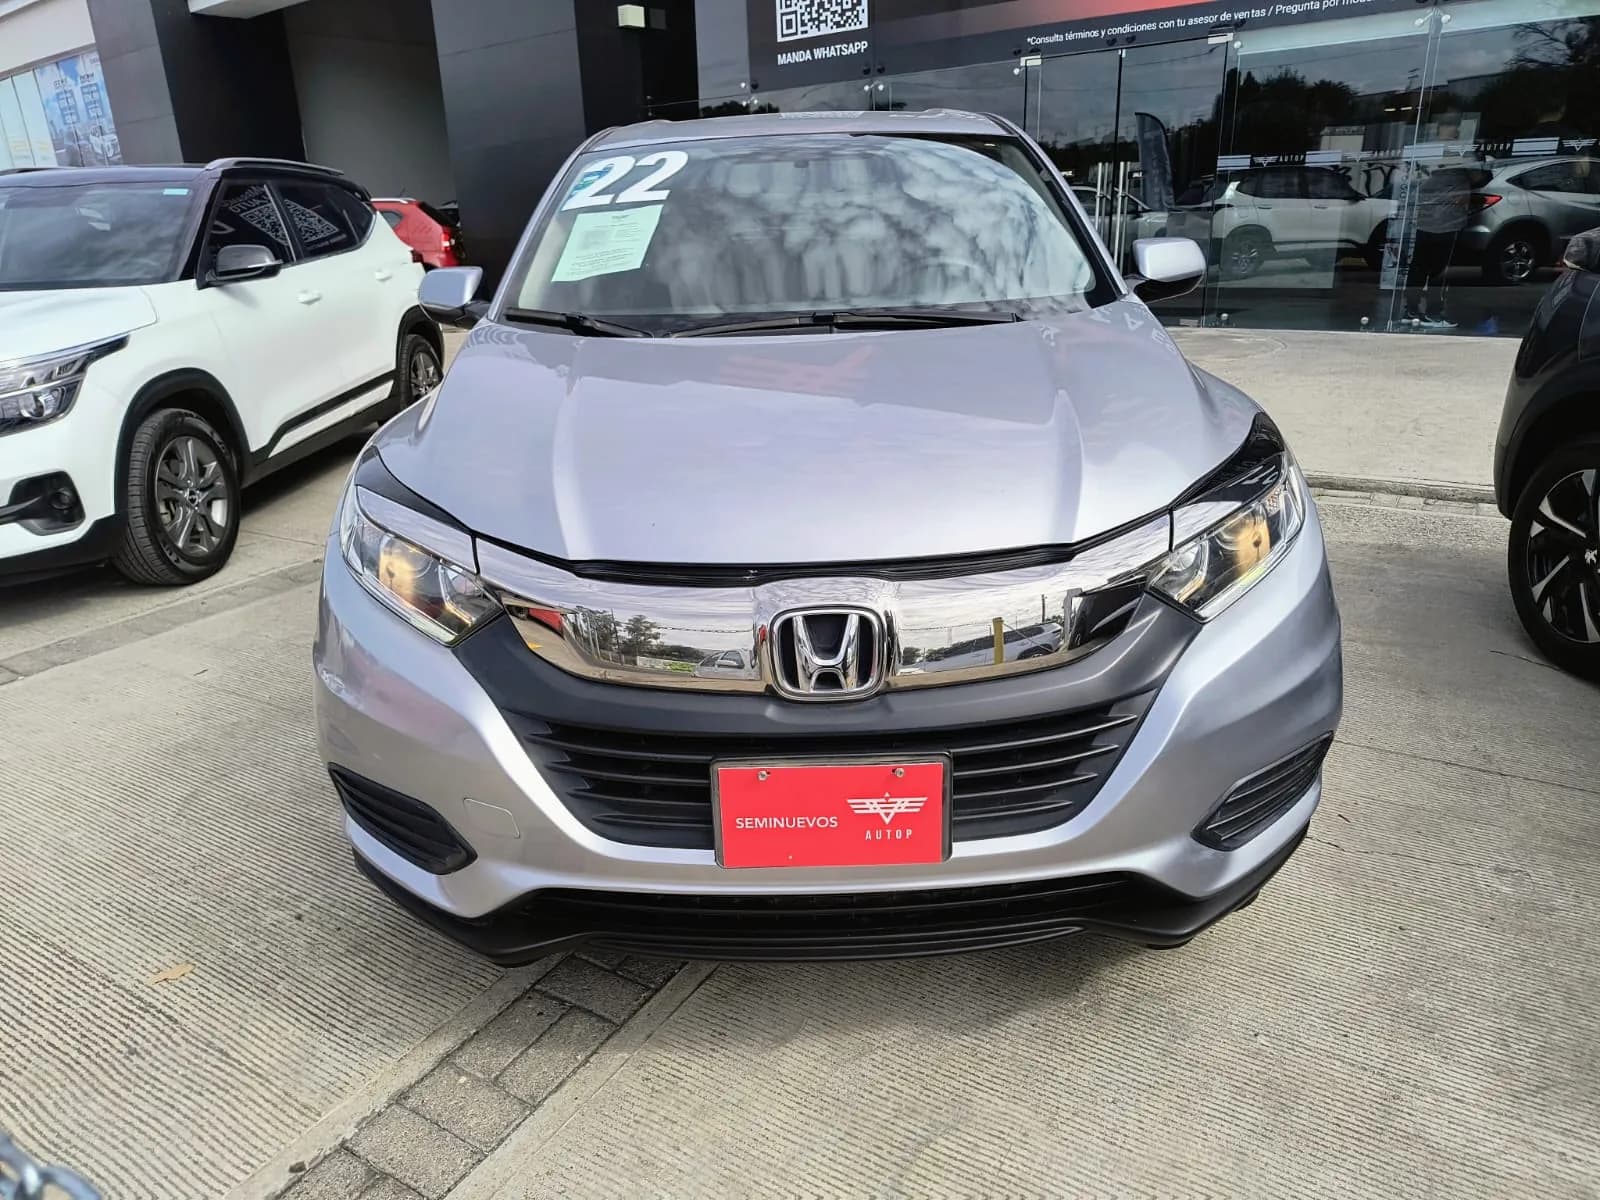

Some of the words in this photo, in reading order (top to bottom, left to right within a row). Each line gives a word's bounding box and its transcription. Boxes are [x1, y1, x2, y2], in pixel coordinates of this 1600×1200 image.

[1065, 29, 1100, 41] términos
[1101, 27, 1106, 39] y
[1107, 22, 1157, 36] condiciones
[1158, 20, 1175, 30] con
[1177, 17, 1186, 27] tu
[1188, 14, 1218, 26] asesor
[1220, 11, 1232, 22] de
[1275, 0, 1320, 15] Pregunta
[1322, 0, 1340, 11] por
[777, 49, 812, 66] MANDA
[813, 40, 869, 60] WHATSAPP
[1480, 142, 1511, 151] AUTOP
[1279, 154, 1304, 163] AUTOP
[560, 150, 689, 212] 22
[735, 815, 839, 829] SEMINUEVOS
[865, 829, 913, 841] AUTOP
